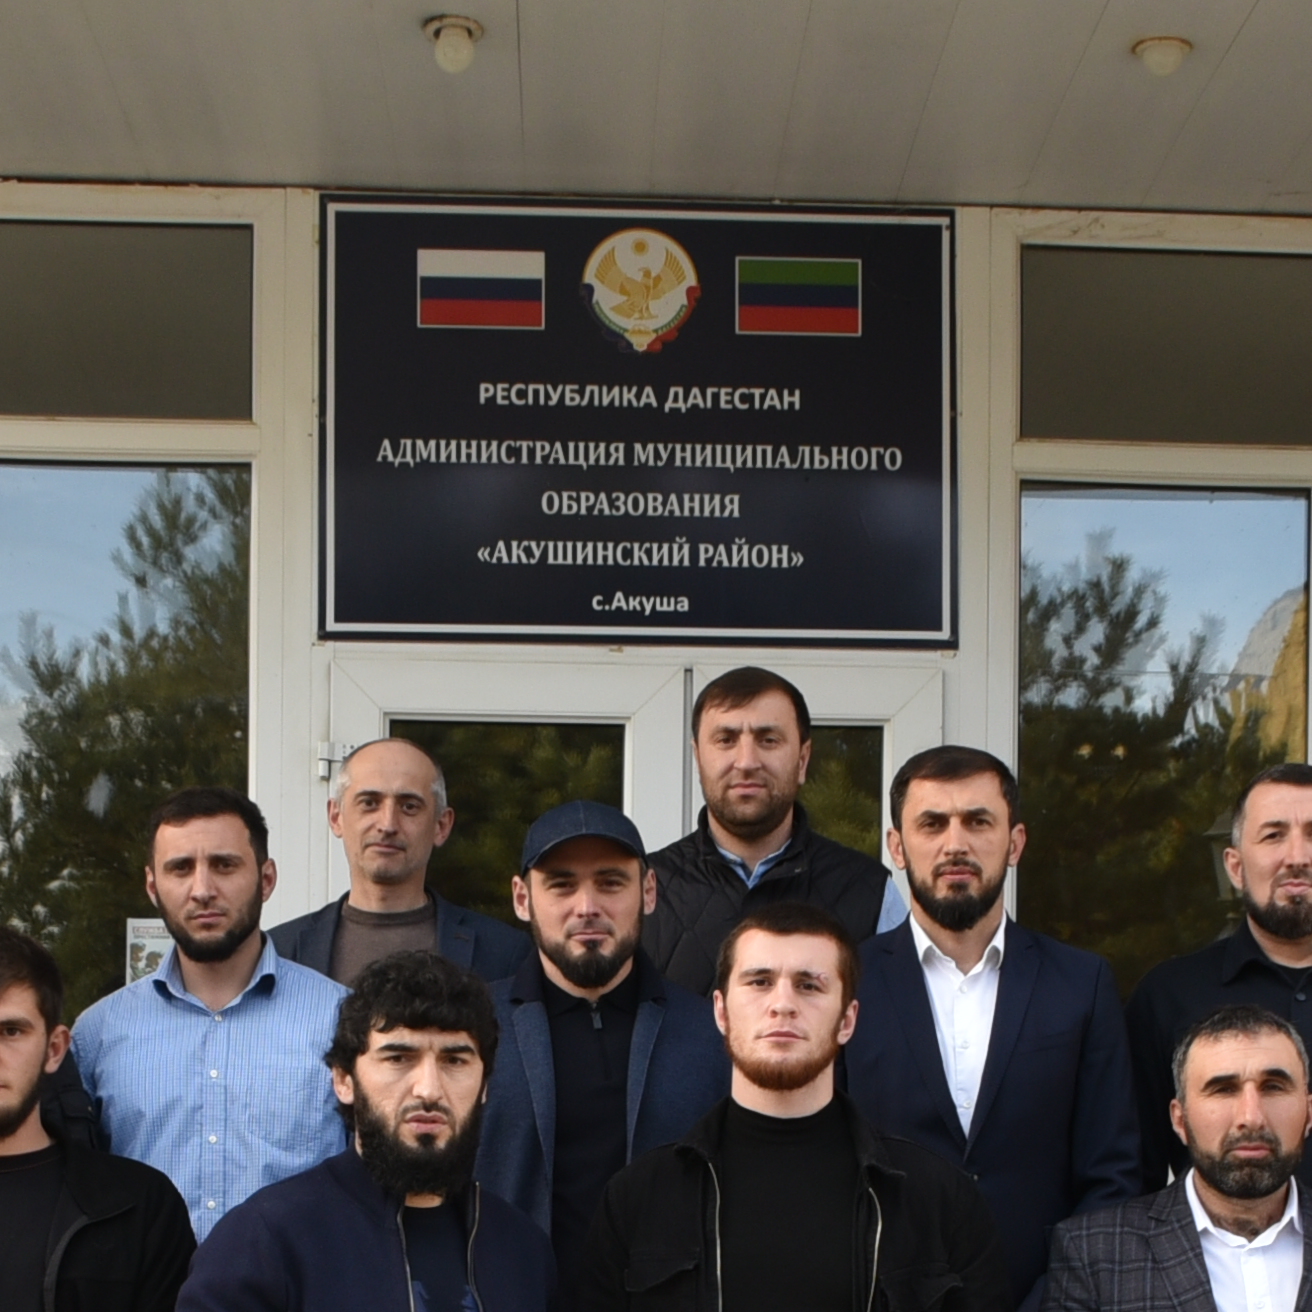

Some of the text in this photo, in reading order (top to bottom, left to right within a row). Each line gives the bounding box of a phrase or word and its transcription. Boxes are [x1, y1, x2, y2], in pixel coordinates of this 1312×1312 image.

[479, 382, 800, 413] РЕСПУБЛИКА ДАГЕСТАН
[377, 438, 902, 473] АДМИНИСТРАЦИЯ МУНИЦИПАЛЬНОГО
[541, 490, 740, 518] ОБРАЗОВАНИЯ
[477, 536, 804, 568] «АКУШИНСКИЙ РАЙОН»
[591, 591, 689, 616] с.Акуша
